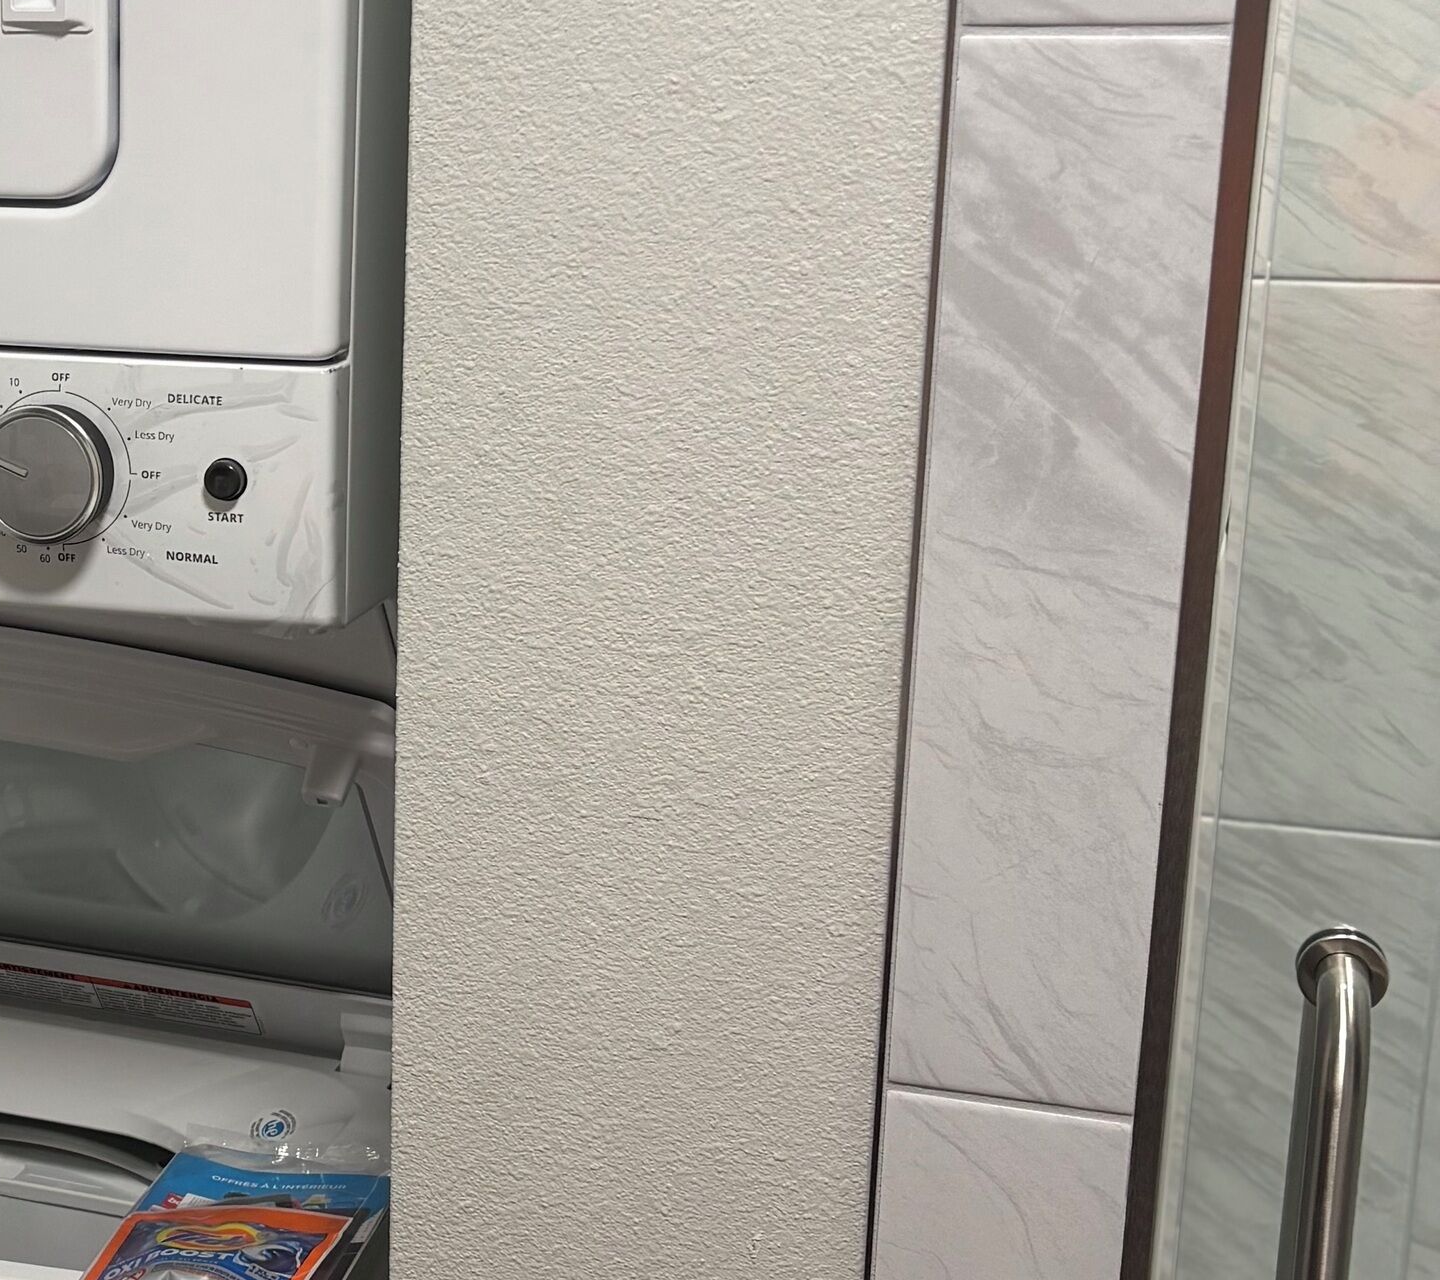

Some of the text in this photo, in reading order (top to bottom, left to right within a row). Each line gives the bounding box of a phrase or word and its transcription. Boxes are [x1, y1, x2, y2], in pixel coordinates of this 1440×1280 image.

[9, 377, 20, 387] 10
[51, 372, 71, 382] OFF
[111, 397, 152, 410] Very Dry
[167, 393, 223, 406] DELICATE
[134, 429, 175, 443] Less Dry
[141, 470, 162, 480] OFF
[207, 511, 245, 523] START
[131, 519, 172, 534] Very Dry
[16, 544, 28, 554] 50
[106, 545, 146, 560] Less Dry
[40, 553, 51, 563] 60
[57, 552, 76, 562] OFF
[166, 550, 219, 565] NORMAL
[104, 1258, 141, 1280] OXI
[145, 1248, 235, 1263] BOOST
